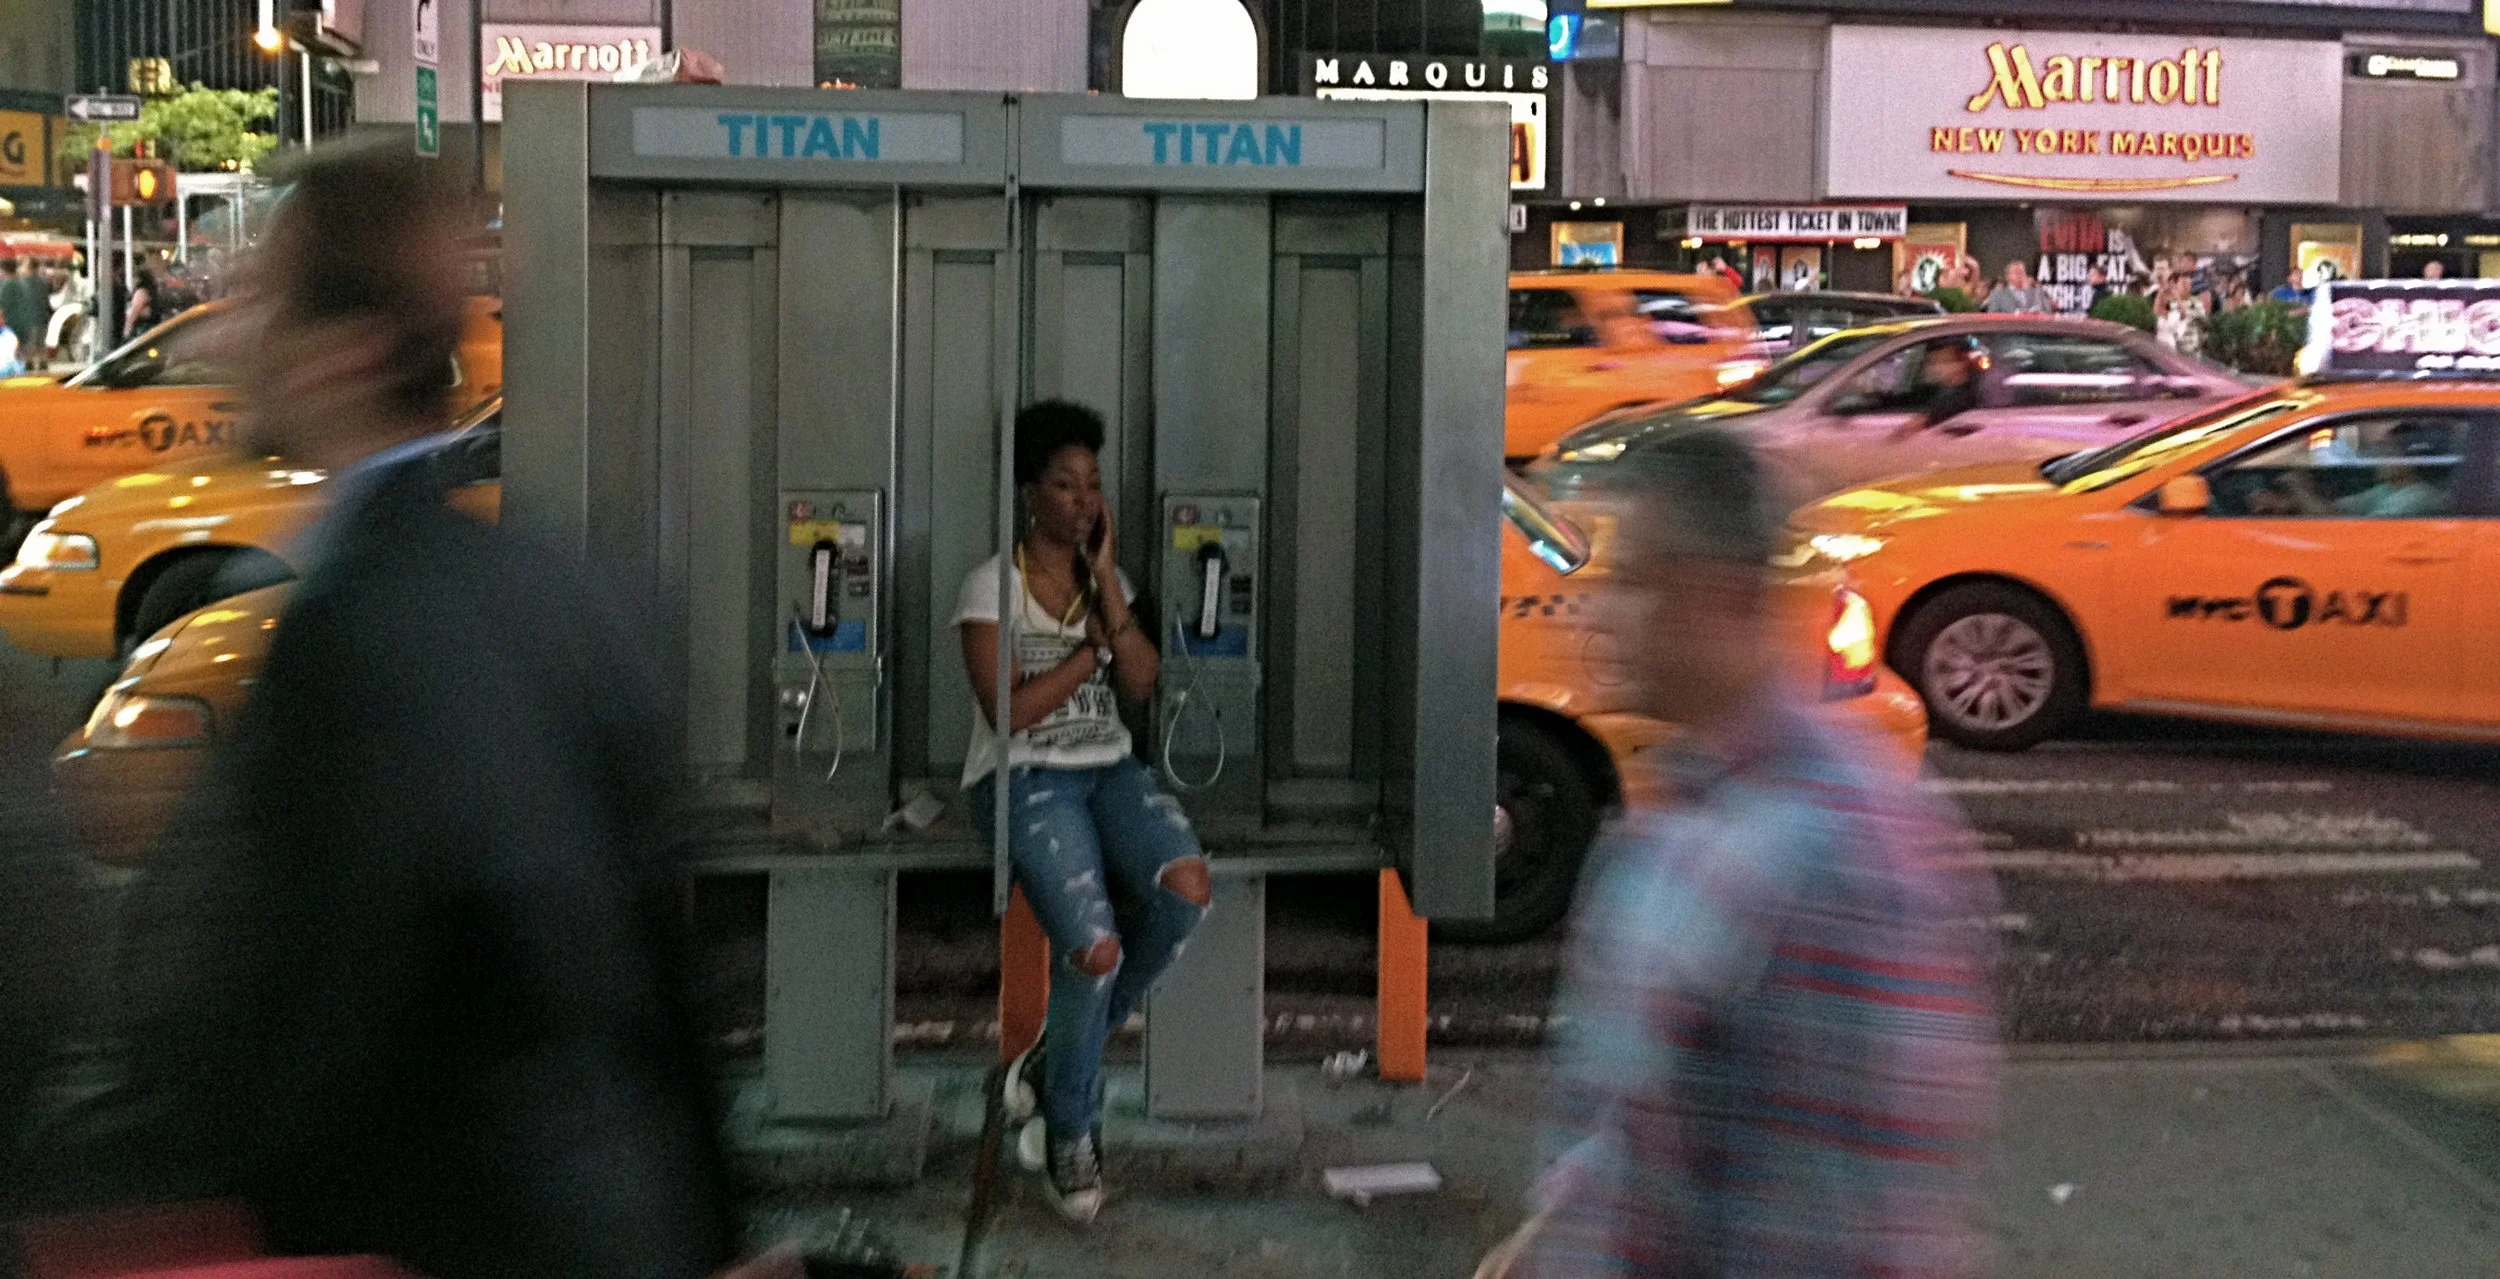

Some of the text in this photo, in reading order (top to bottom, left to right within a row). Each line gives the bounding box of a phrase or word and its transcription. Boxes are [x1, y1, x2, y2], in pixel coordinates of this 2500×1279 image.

[485, 36, 650, 75] Marriott
[1315, 58, 1549, 89] MARQUIS
[1965, 41, 2222, 112] Marriott
[717, 114, 880, 160] TITAN
[1143, 123, 1302, 165] TITAN
[1930, 126, 2256, 161] NEW YORK MARQUIS
[1695, 209, 1901, 232] THE HOTTEST TICKET IN TOWN!
[2037, 254, 2051, 282] A
[2056, 254, 2088, 282] BIG
[2256, 575, 2410, 631] TAXI
